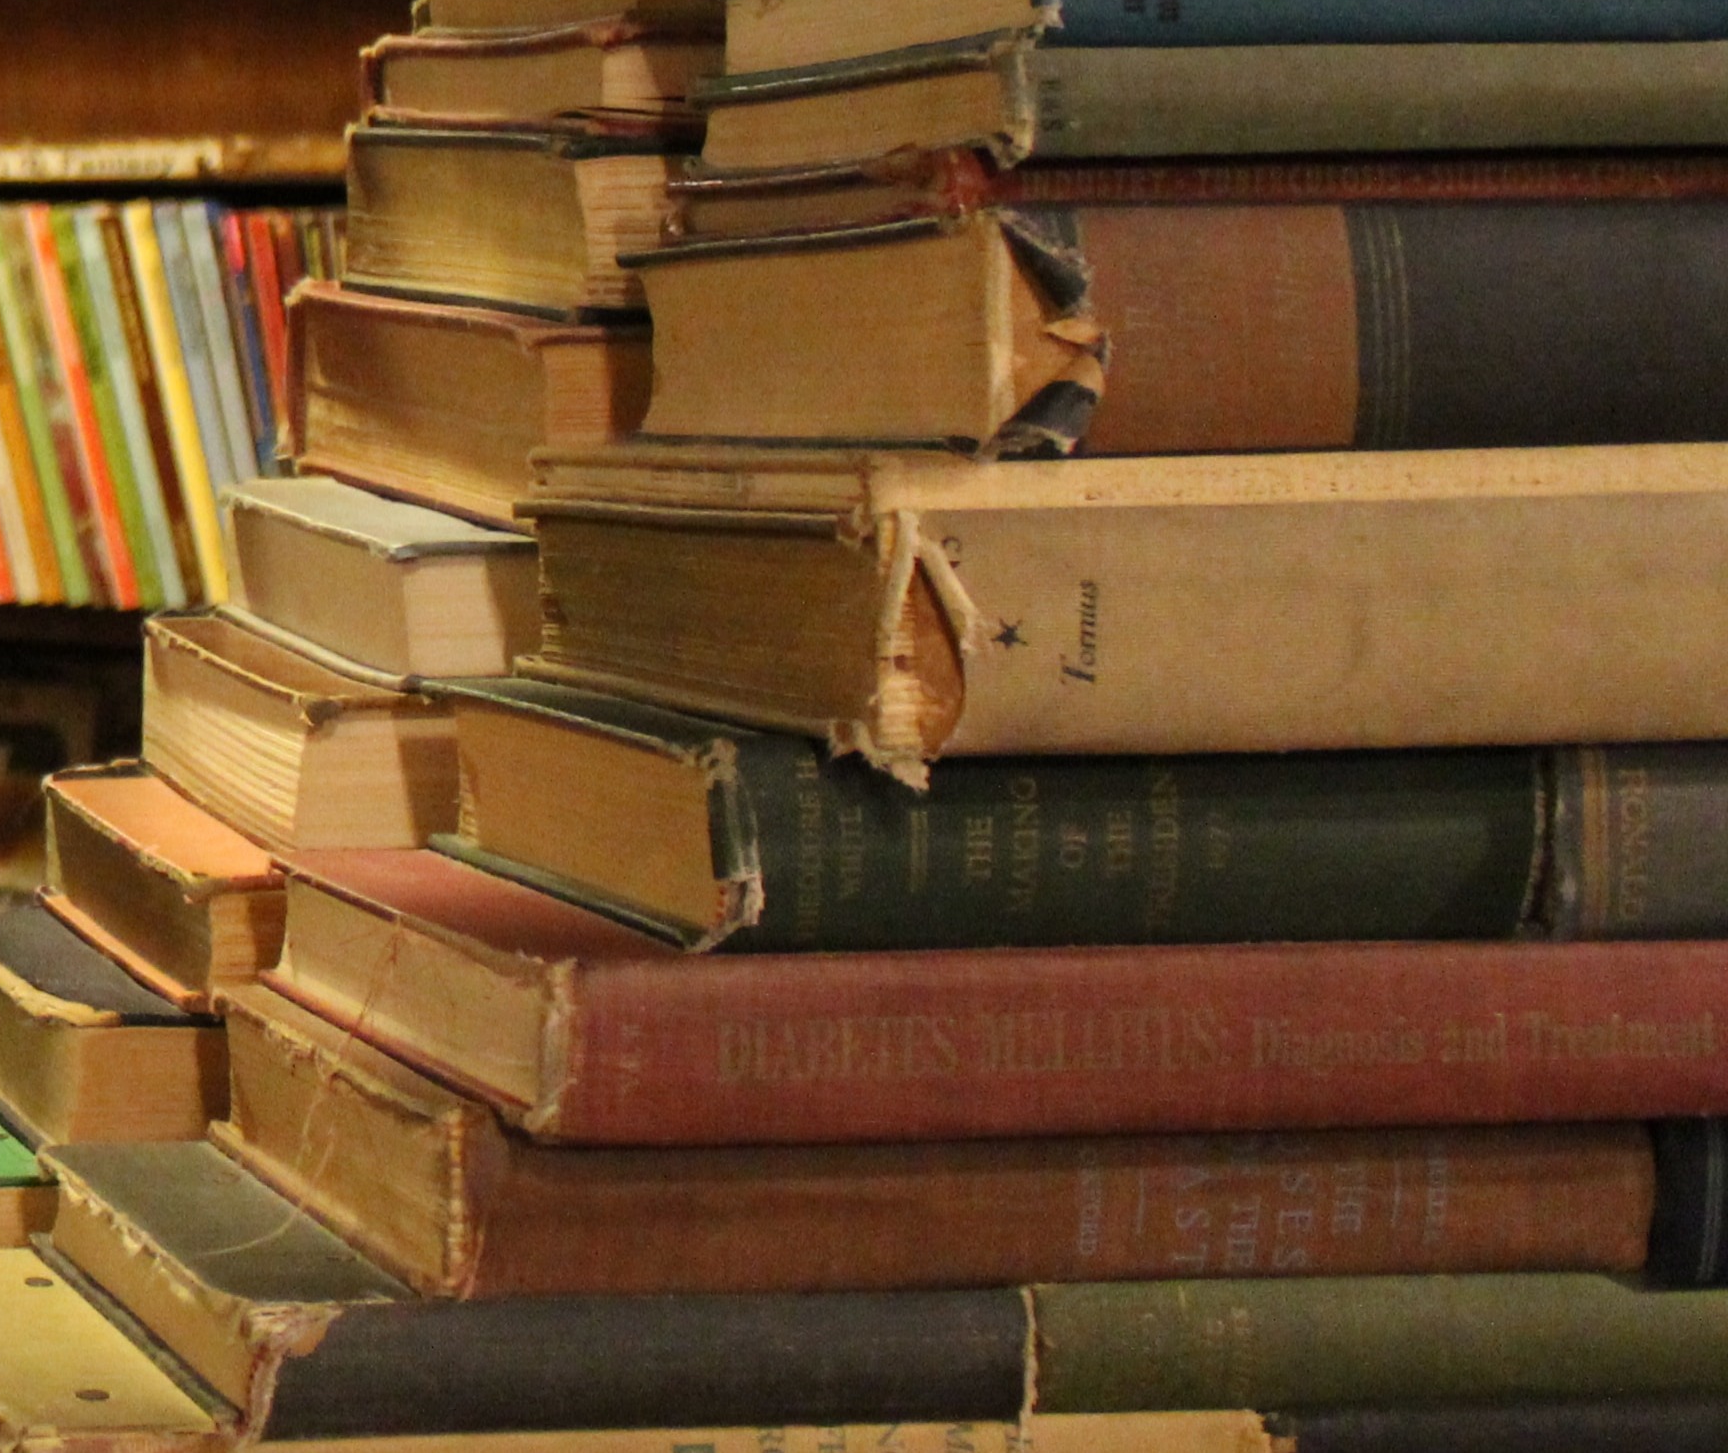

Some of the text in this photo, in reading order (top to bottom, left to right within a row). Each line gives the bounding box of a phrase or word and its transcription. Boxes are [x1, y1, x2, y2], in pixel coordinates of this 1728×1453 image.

[964, 815, 995, 886] THE
[999, 775, 1041, 913] MAKING
[1058, 820, 1089, 870] OF
[1146, 764, 1181, 930] PRESIDEN
[715, 1013, 958, 1082] DIABETES
[1441, 1009, 1508, 1065] and
[1523, 1009, 1716, 1059] Treatment
[1170, 1164, 1212, 1272] AST
